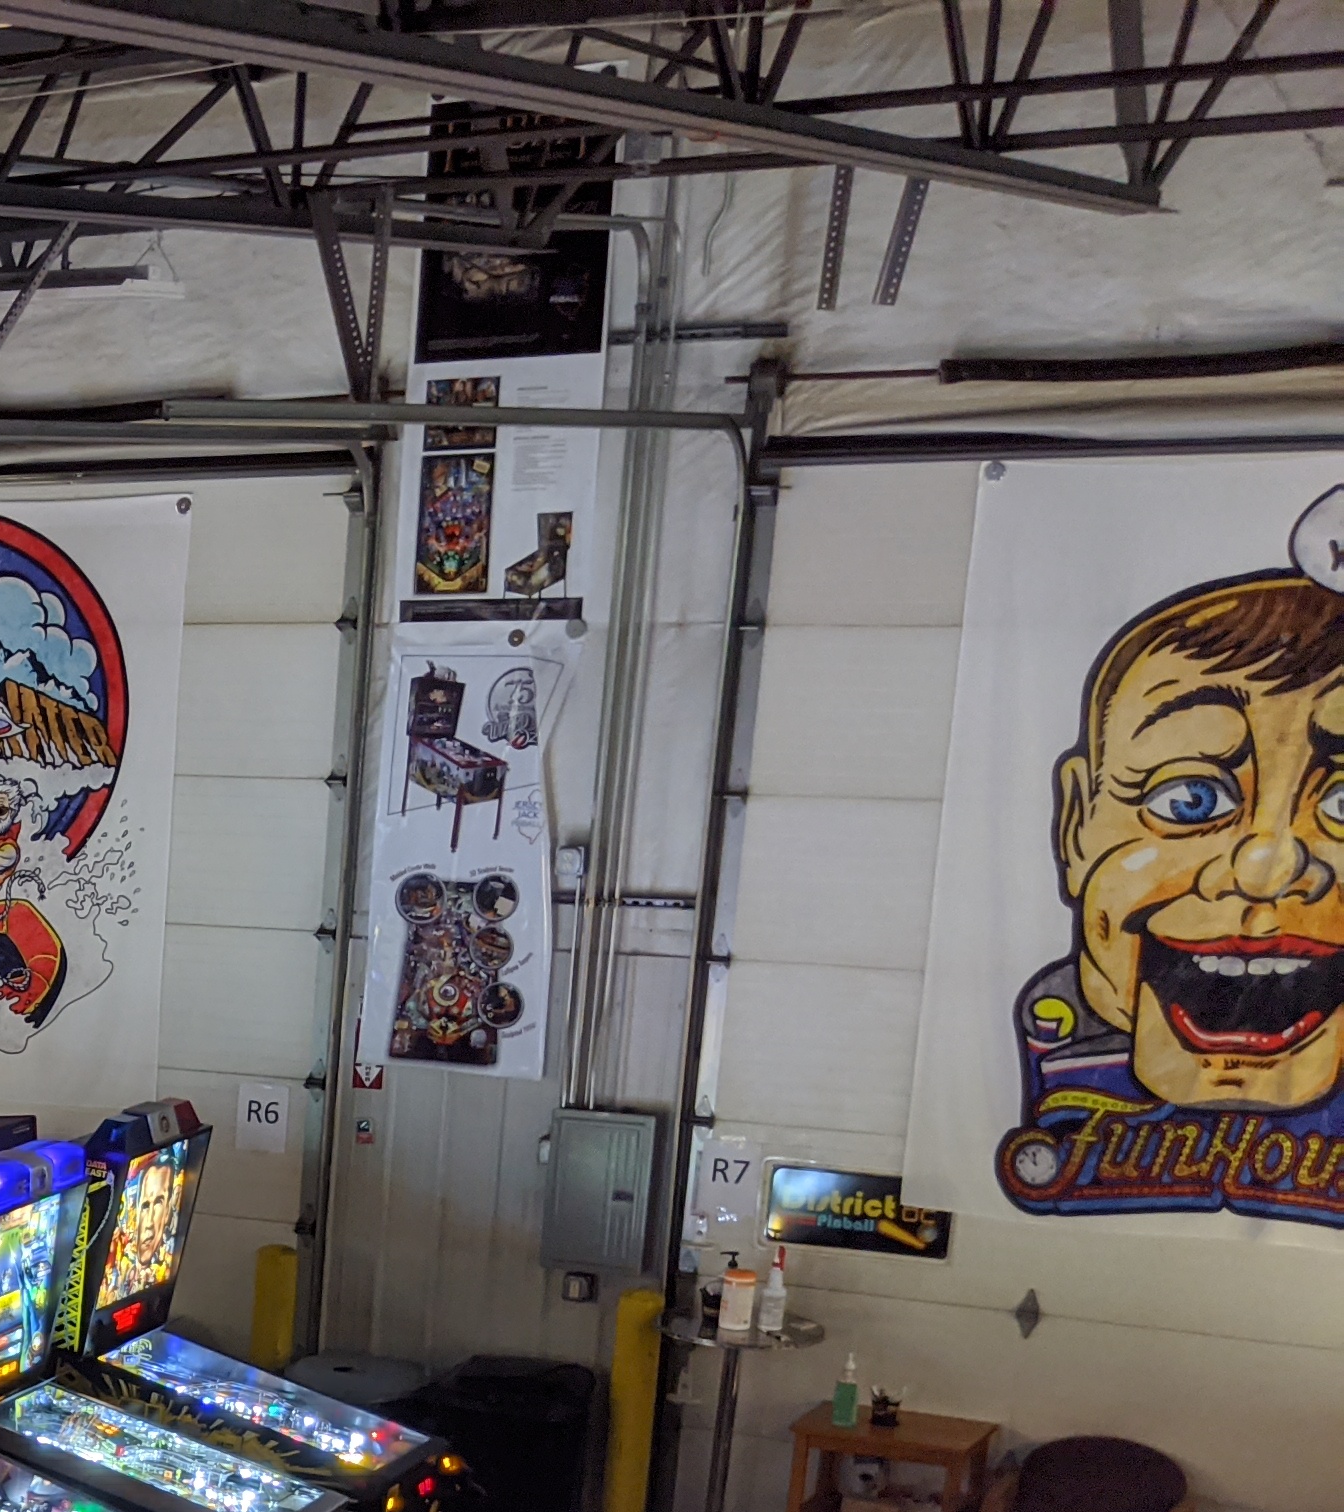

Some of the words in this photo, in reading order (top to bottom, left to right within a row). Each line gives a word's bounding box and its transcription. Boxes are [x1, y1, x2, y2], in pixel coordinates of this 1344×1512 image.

[247, 1101, 280, 1124] R6
[85, 1168, 108, 1178] EAST
[86, 1160, 107, 1169] DATA
[712, 1157, 750, 1184] R7
[816, 1213, 876, 1232] Pinball
